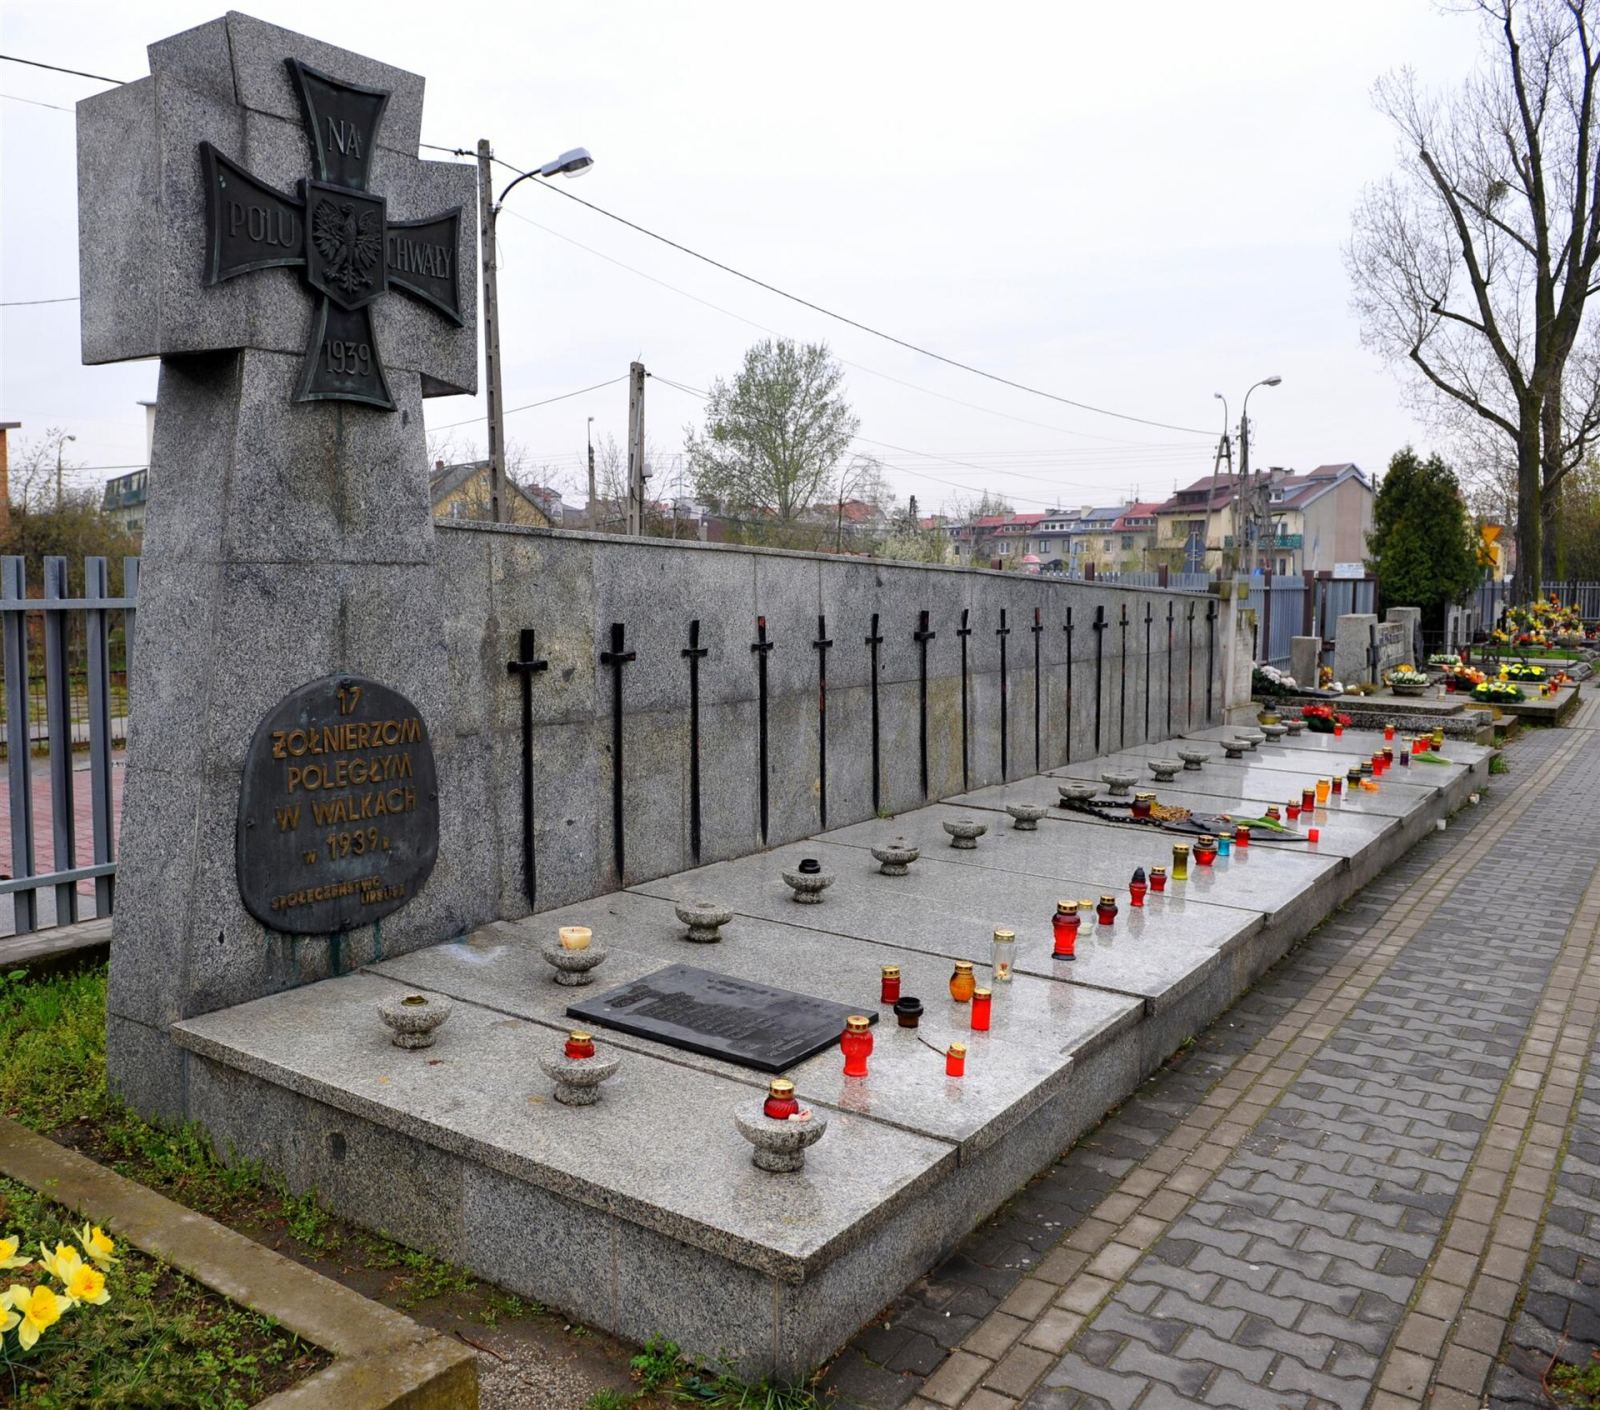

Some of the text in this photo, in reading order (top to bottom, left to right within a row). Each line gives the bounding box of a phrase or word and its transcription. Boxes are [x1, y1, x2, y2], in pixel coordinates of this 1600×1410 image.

[327, 117, 361, 160] NA
[228, 202, 296, 248] POLU
[386, 236, 453, 280] CHWAŁY
[323, 339, 372, 376] 1939
[337, 686, 362, 716] 17
[287, 752, 413, 794] POLEGŁYM
[275, 786, 417, 832] W WALKACH
[326, 826, 378, 861] 1939
